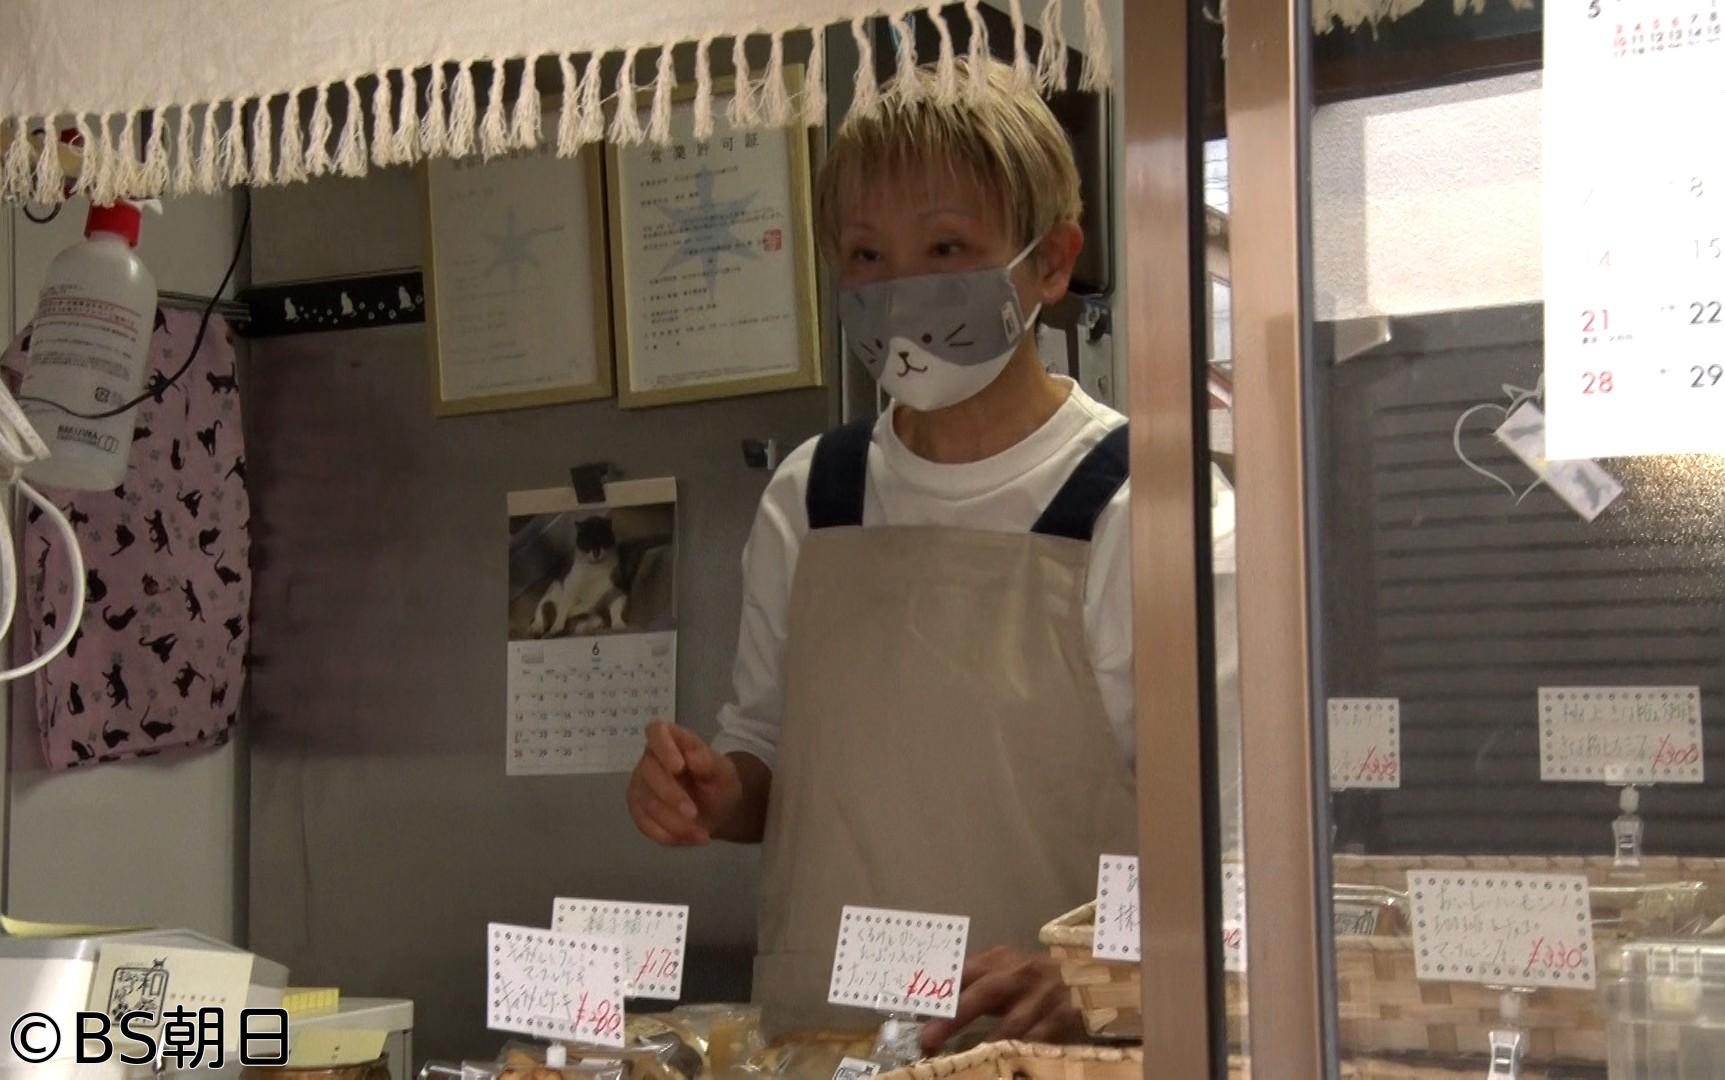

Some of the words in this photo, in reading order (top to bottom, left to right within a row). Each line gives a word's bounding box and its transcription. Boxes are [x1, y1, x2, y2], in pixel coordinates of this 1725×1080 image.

[1588, 0, 1602, 18] 5
[1581, 309, 1609, 332] 21
[1690, 300, 1722, 325] 22
[1581, 371, 1614, 395] 28
[1690, 363, 1724, 388] 29
[591, 641, 600, 656] 6
[635, 947, 679, 984] ¥170
[1524, 936, 1583, 974] ¥330
[907, 968, 955, 1000] ¥120
